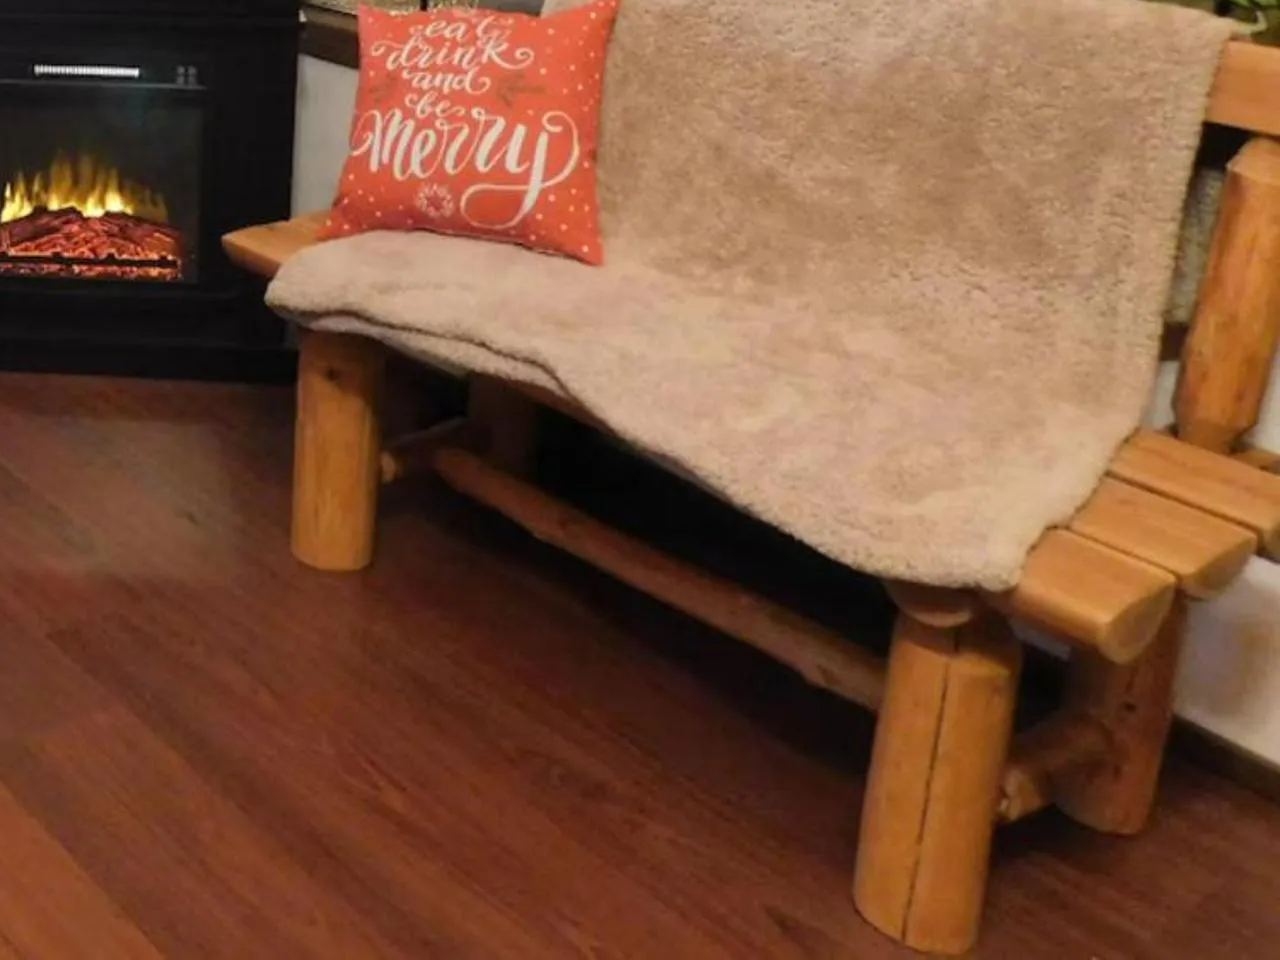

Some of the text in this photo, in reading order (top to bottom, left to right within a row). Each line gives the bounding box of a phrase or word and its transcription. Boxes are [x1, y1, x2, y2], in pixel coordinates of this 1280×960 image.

[372, 35, 534, 70] drink
[402, 66, 491, 94] and
[404, 91, 466, 117] be
